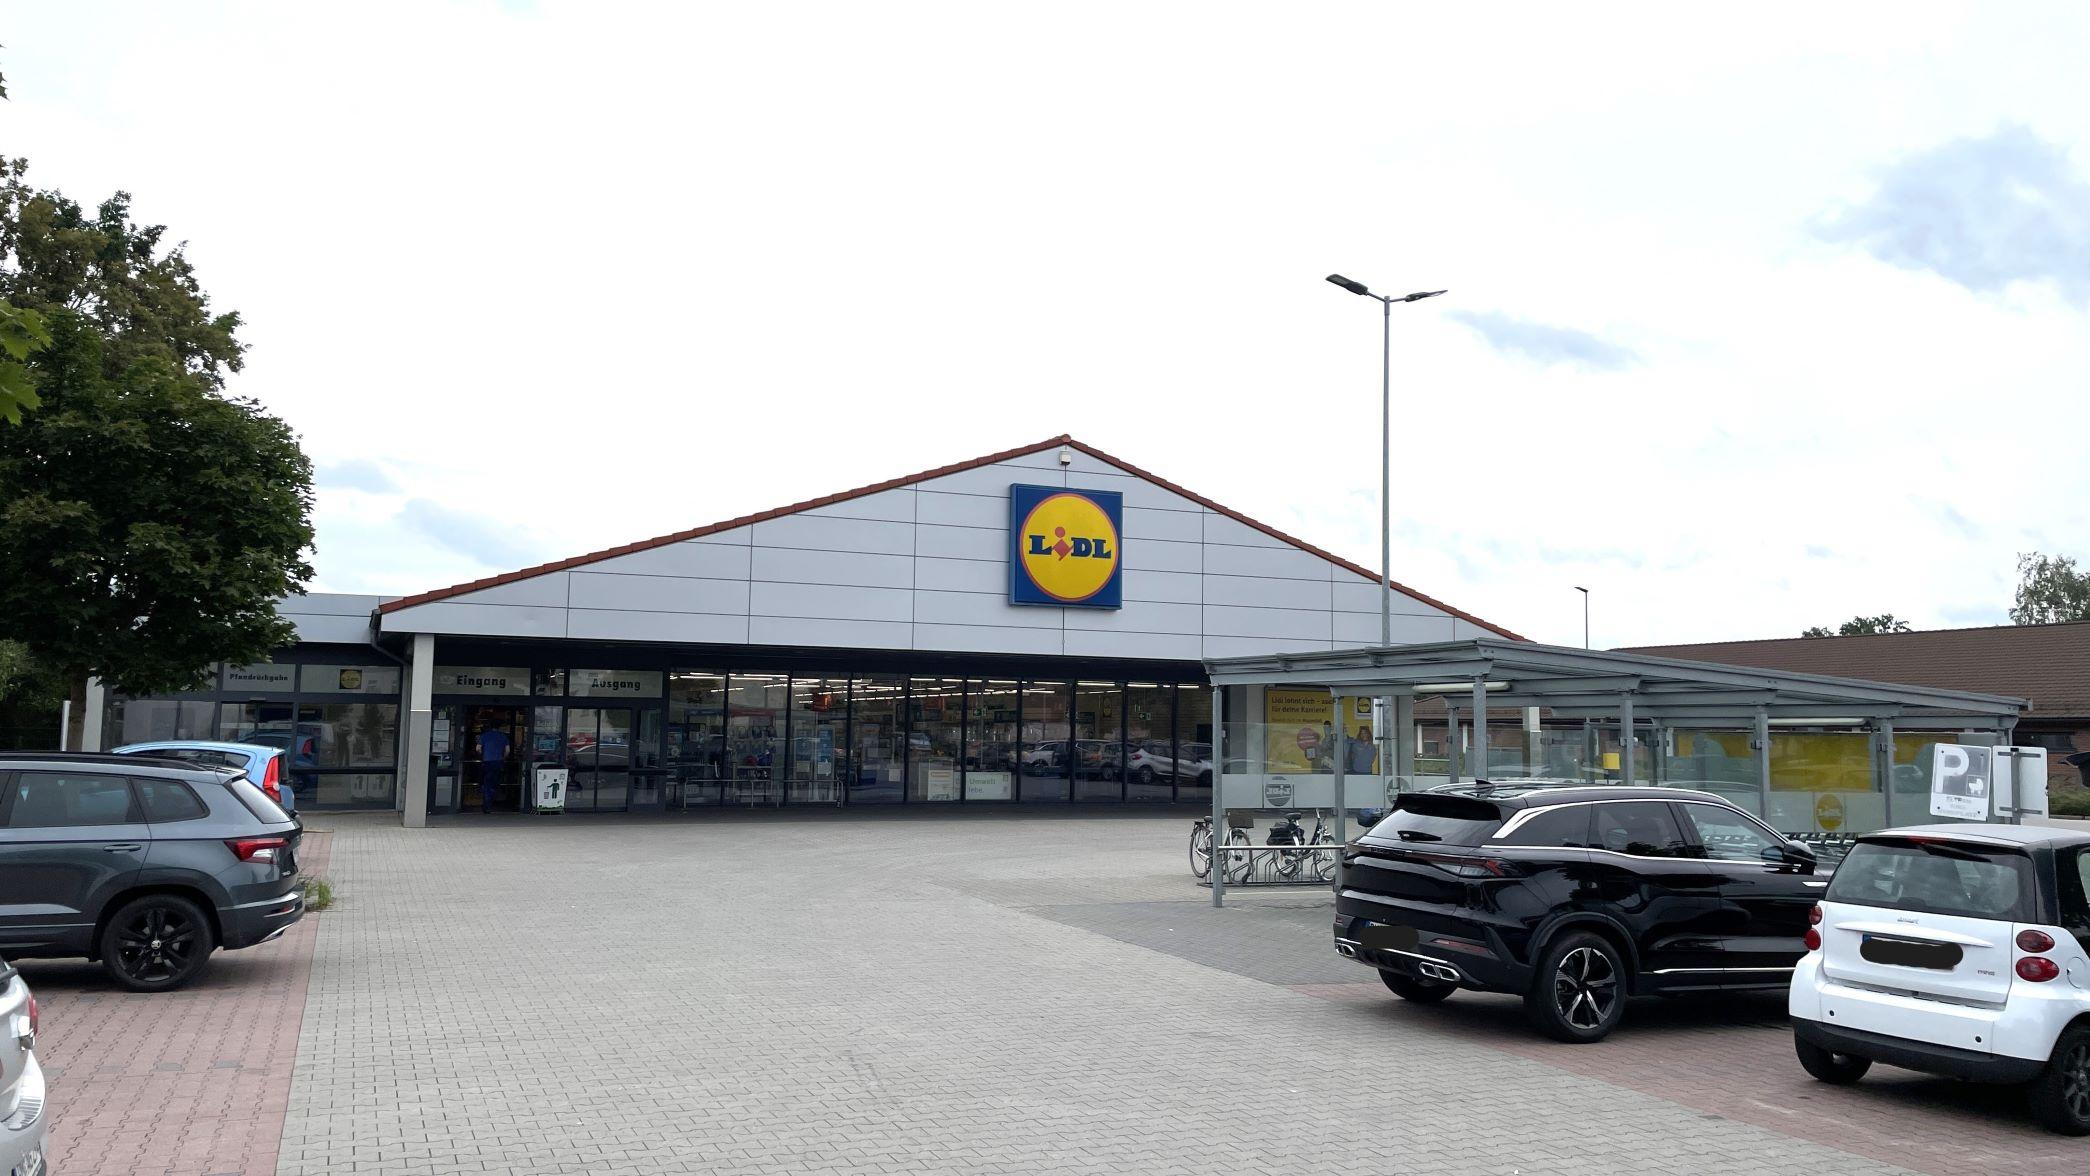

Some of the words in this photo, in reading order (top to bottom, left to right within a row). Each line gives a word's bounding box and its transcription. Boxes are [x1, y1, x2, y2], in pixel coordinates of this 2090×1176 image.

[456, 675, 506, 689] Eingang
[591, 678, 641, 691] Ausgang
[1285, 696, 1301, 704] lohnt
[1303, 697, 1315, 705] sich
[1935, 746, 1970, 794] P
